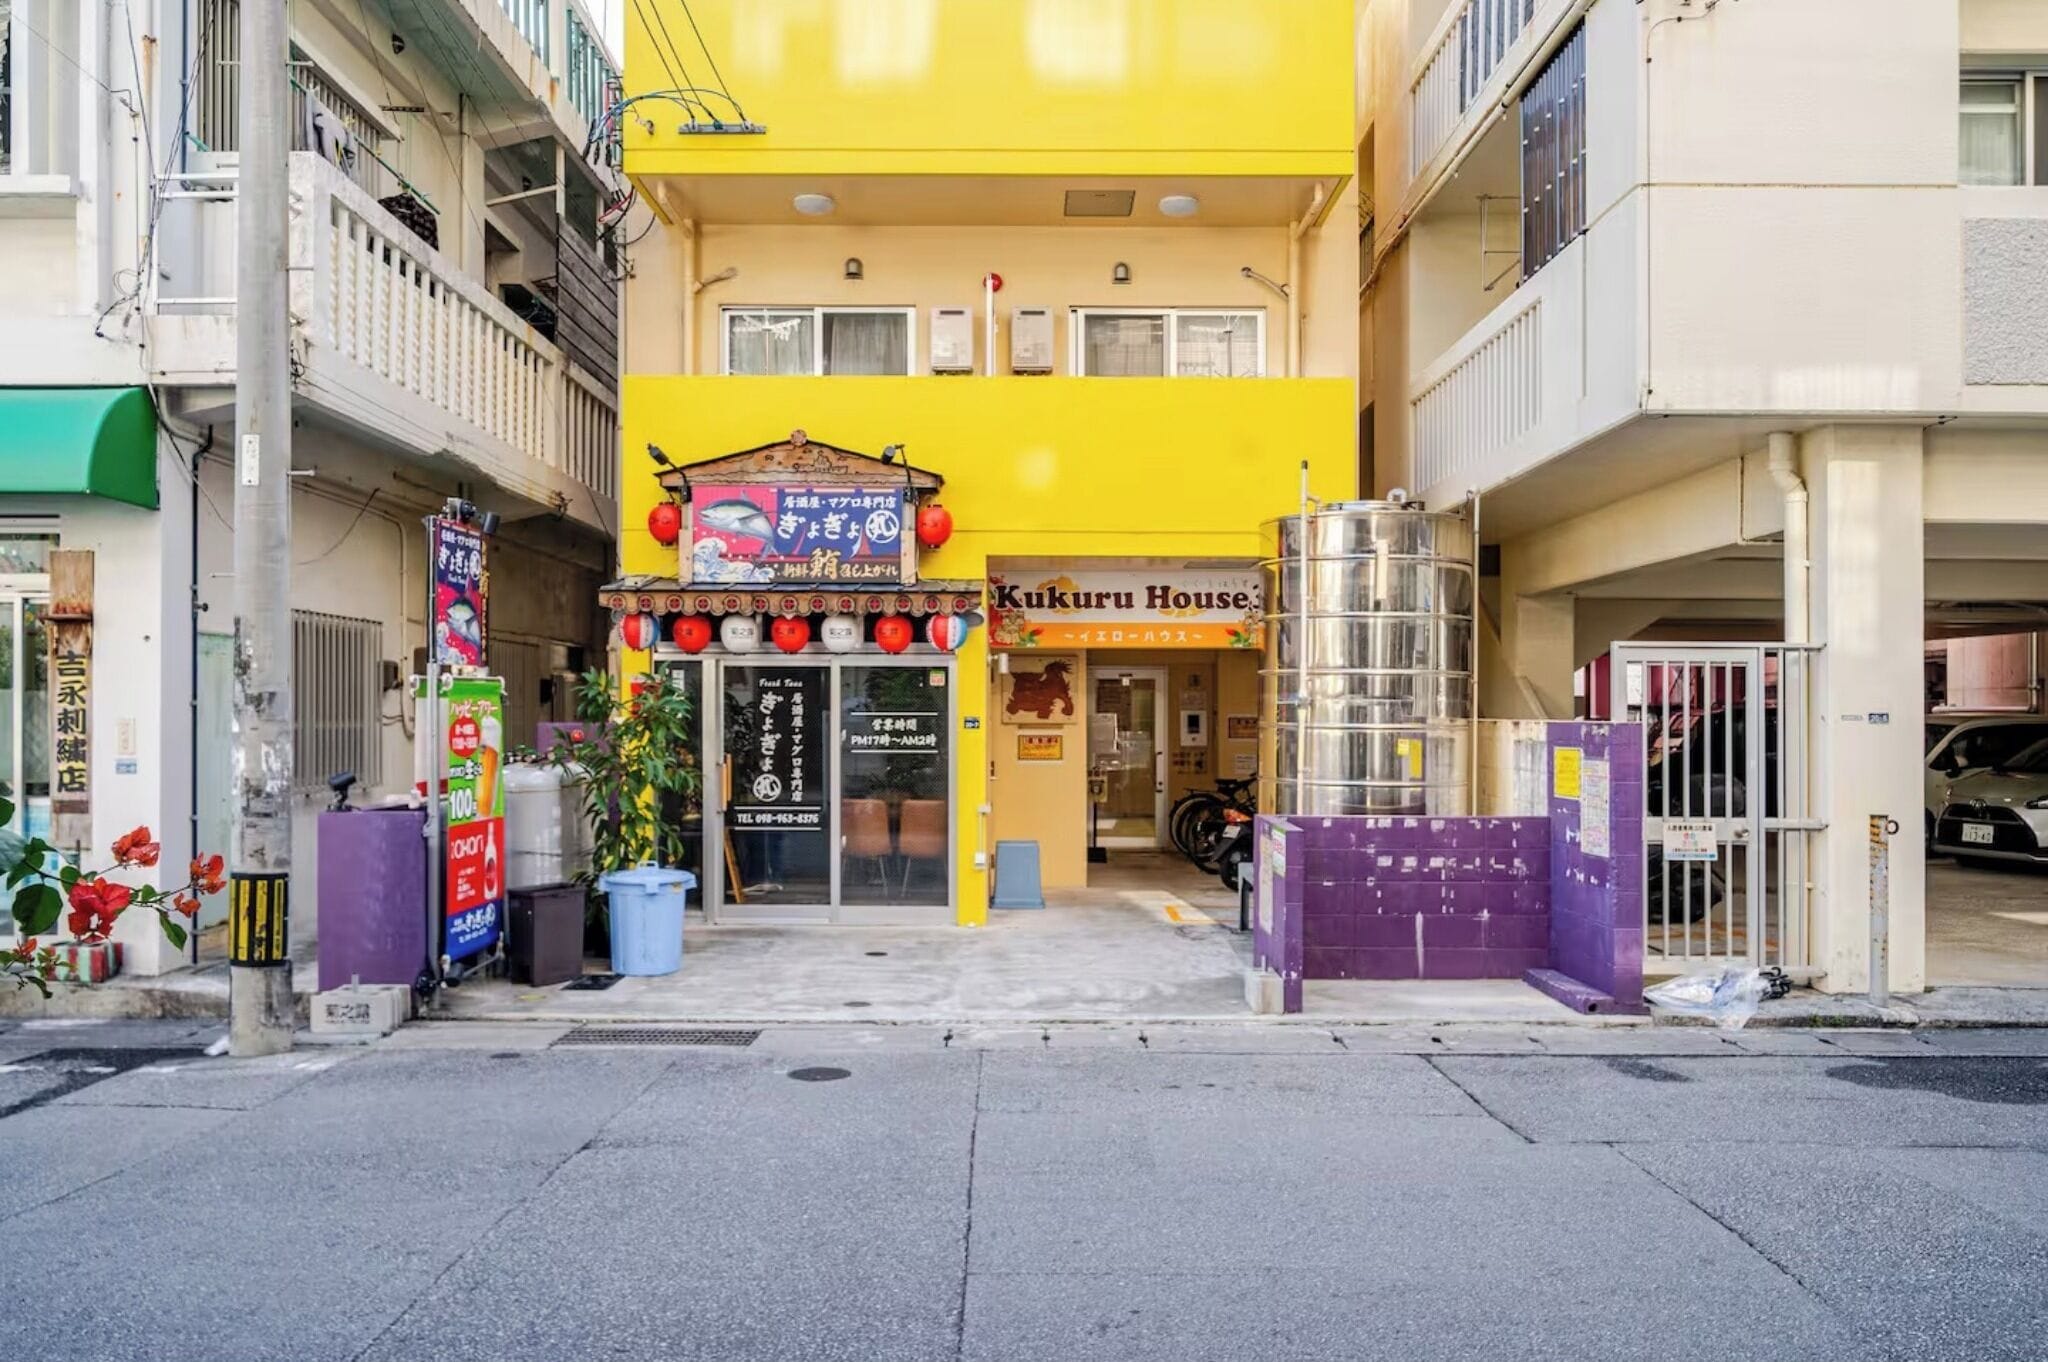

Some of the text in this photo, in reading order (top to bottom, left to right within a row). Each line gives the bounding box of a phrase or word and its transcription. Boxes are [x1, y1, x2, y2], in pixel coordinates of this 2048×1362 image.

[784, 496, 896, 509] 居酒屋・マグロ専門店
[995, 585, 1249, 610] Kukuru House
[872, 718, 918, 731] 営業時間
[737, 812, 754, 824] TEL
